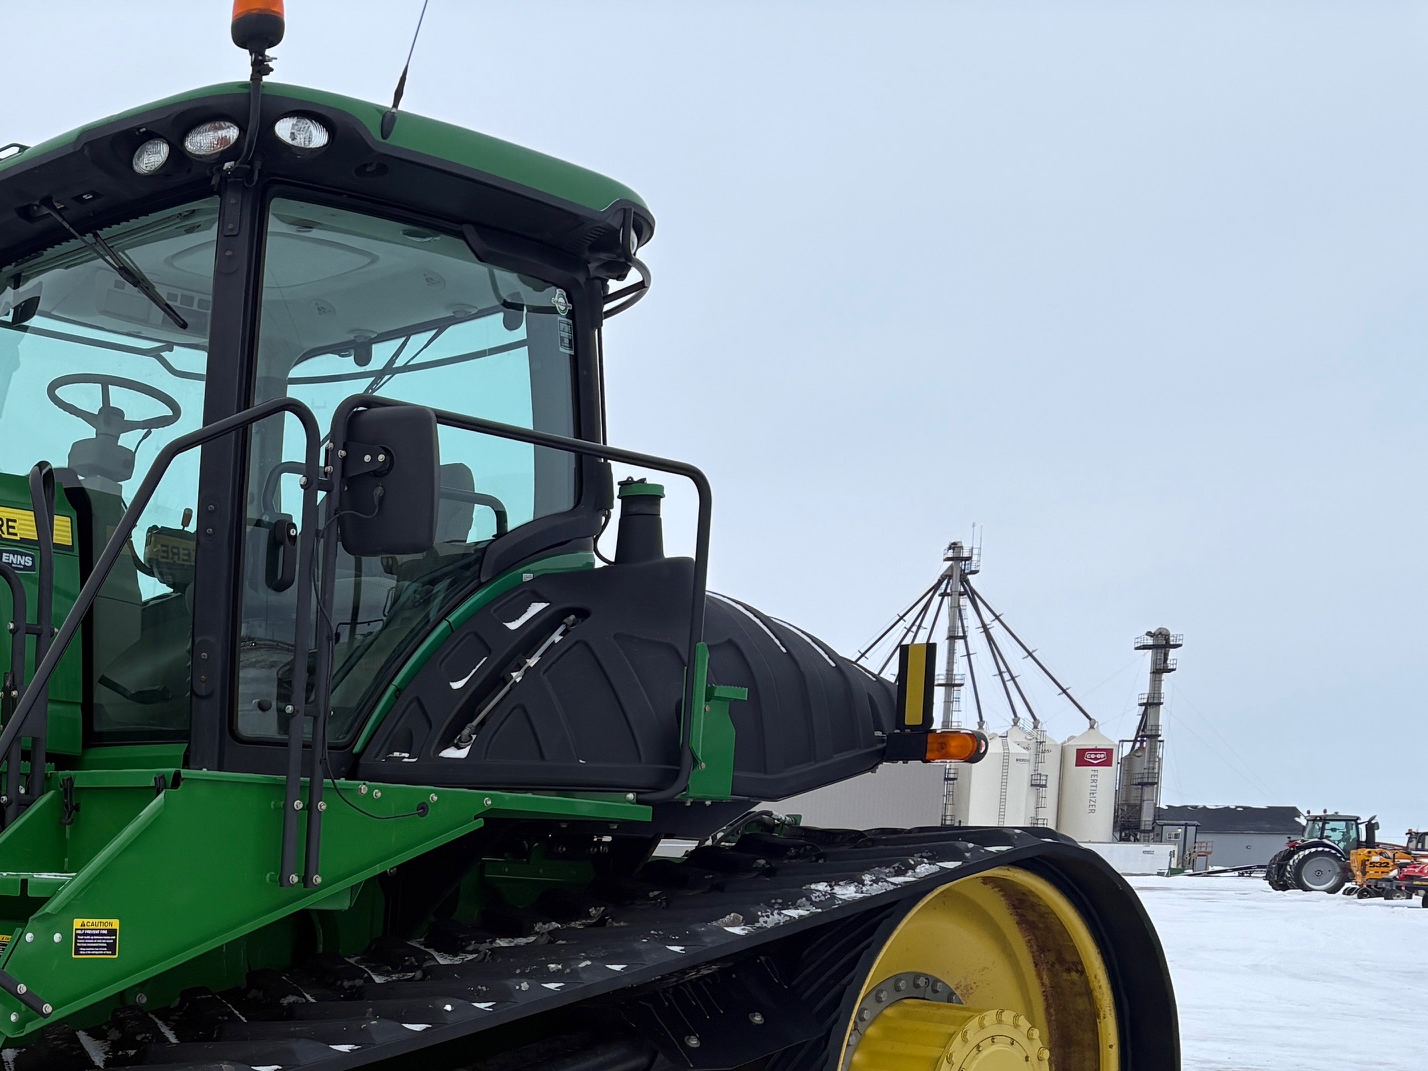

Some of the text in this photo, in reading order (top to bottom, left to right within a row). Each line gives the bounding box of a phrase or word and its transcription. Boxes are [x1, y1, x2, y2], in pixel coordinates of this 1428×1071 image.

[2, 552, 33, 567] ENNS
[1088, 769, 1099, 815] FERTILIZER
[85, 920, 114, 928] CAUTION
